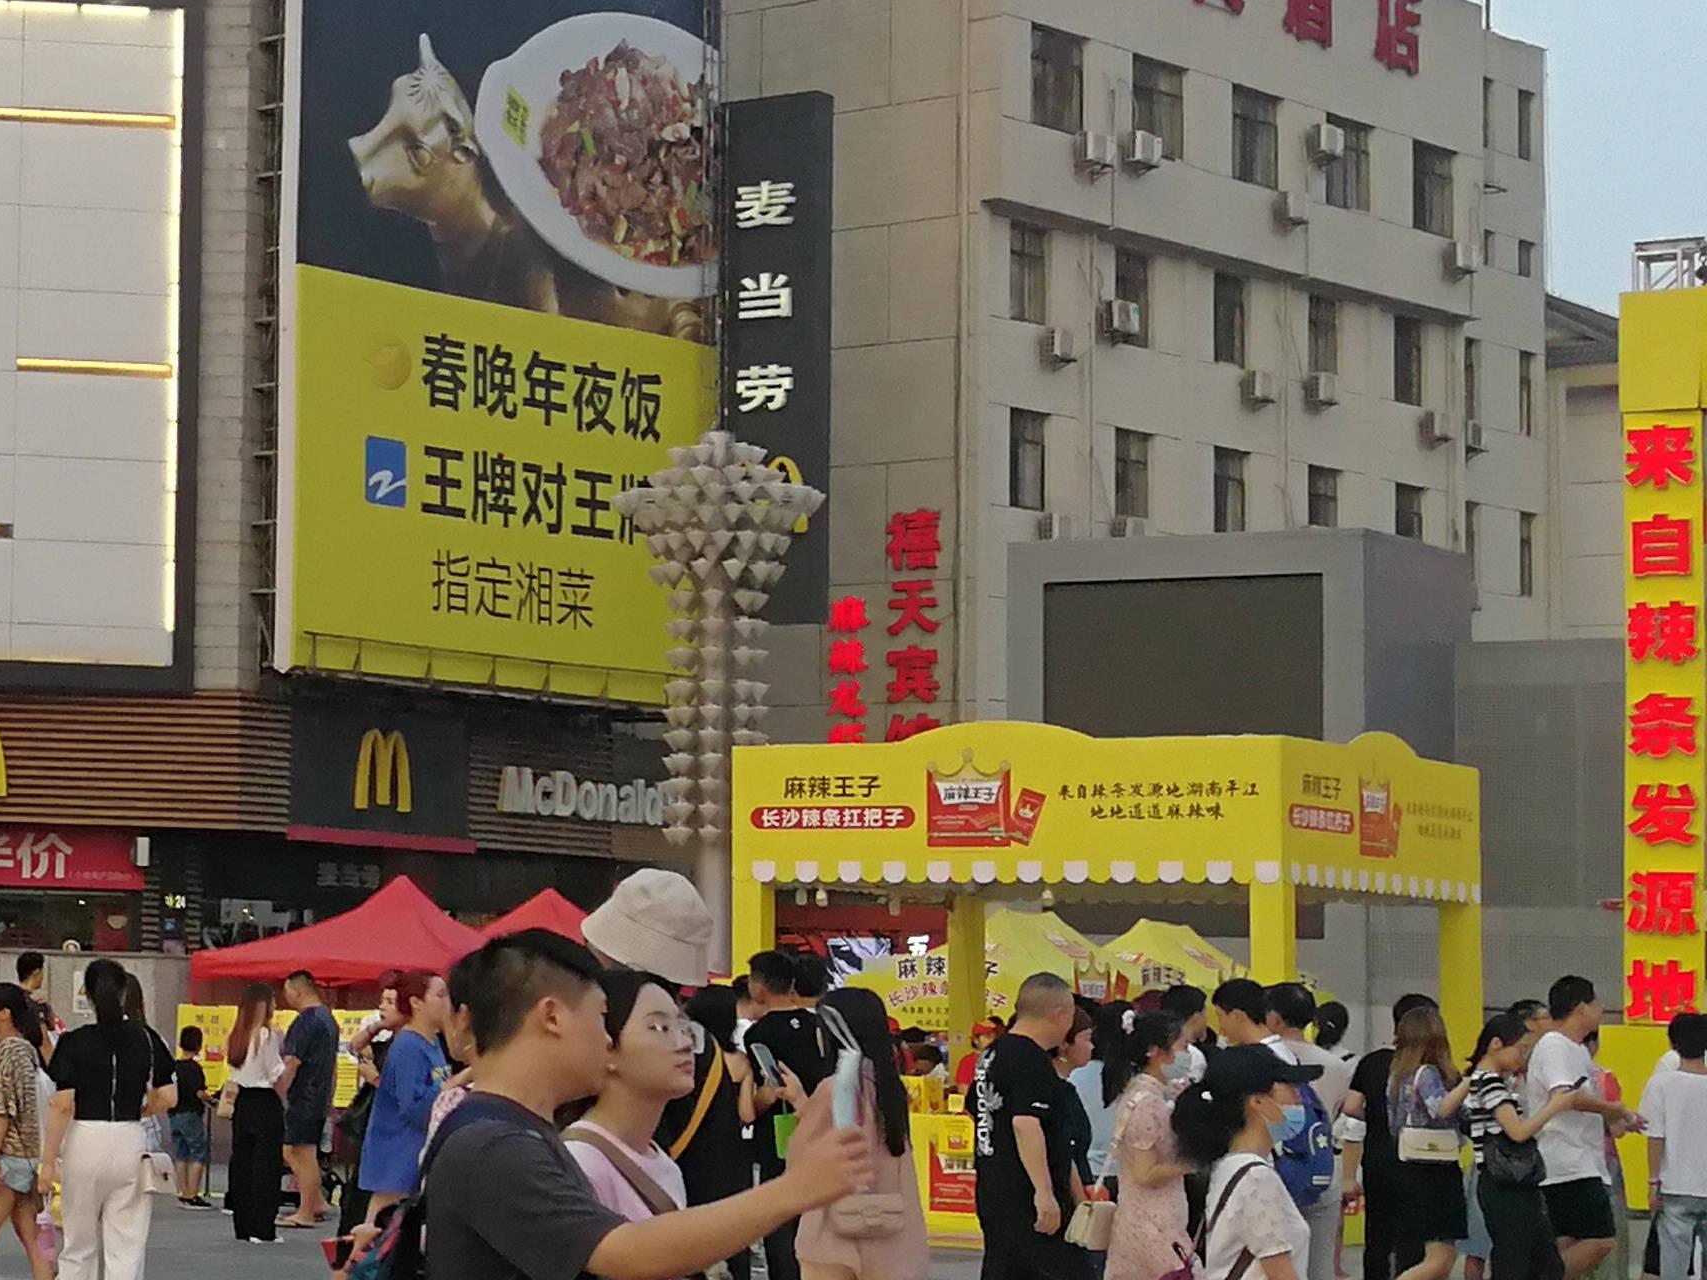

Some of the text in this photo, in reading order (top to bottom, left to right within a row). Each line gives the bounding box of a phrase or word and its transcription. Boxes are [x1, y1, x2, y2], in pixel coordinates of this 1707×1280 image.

[734, 180, 797, 412] 麦当劳
[421, 332, 663, 444] 春晚年夜饭
[431, 548, 597, 630] 指定湘菜
[1625, 423, 1699, 1025] 来自辣条发源地
[783, 775, 882, 799] 麻辣王子
[943, 785, 996, 801] 麻辣王子
